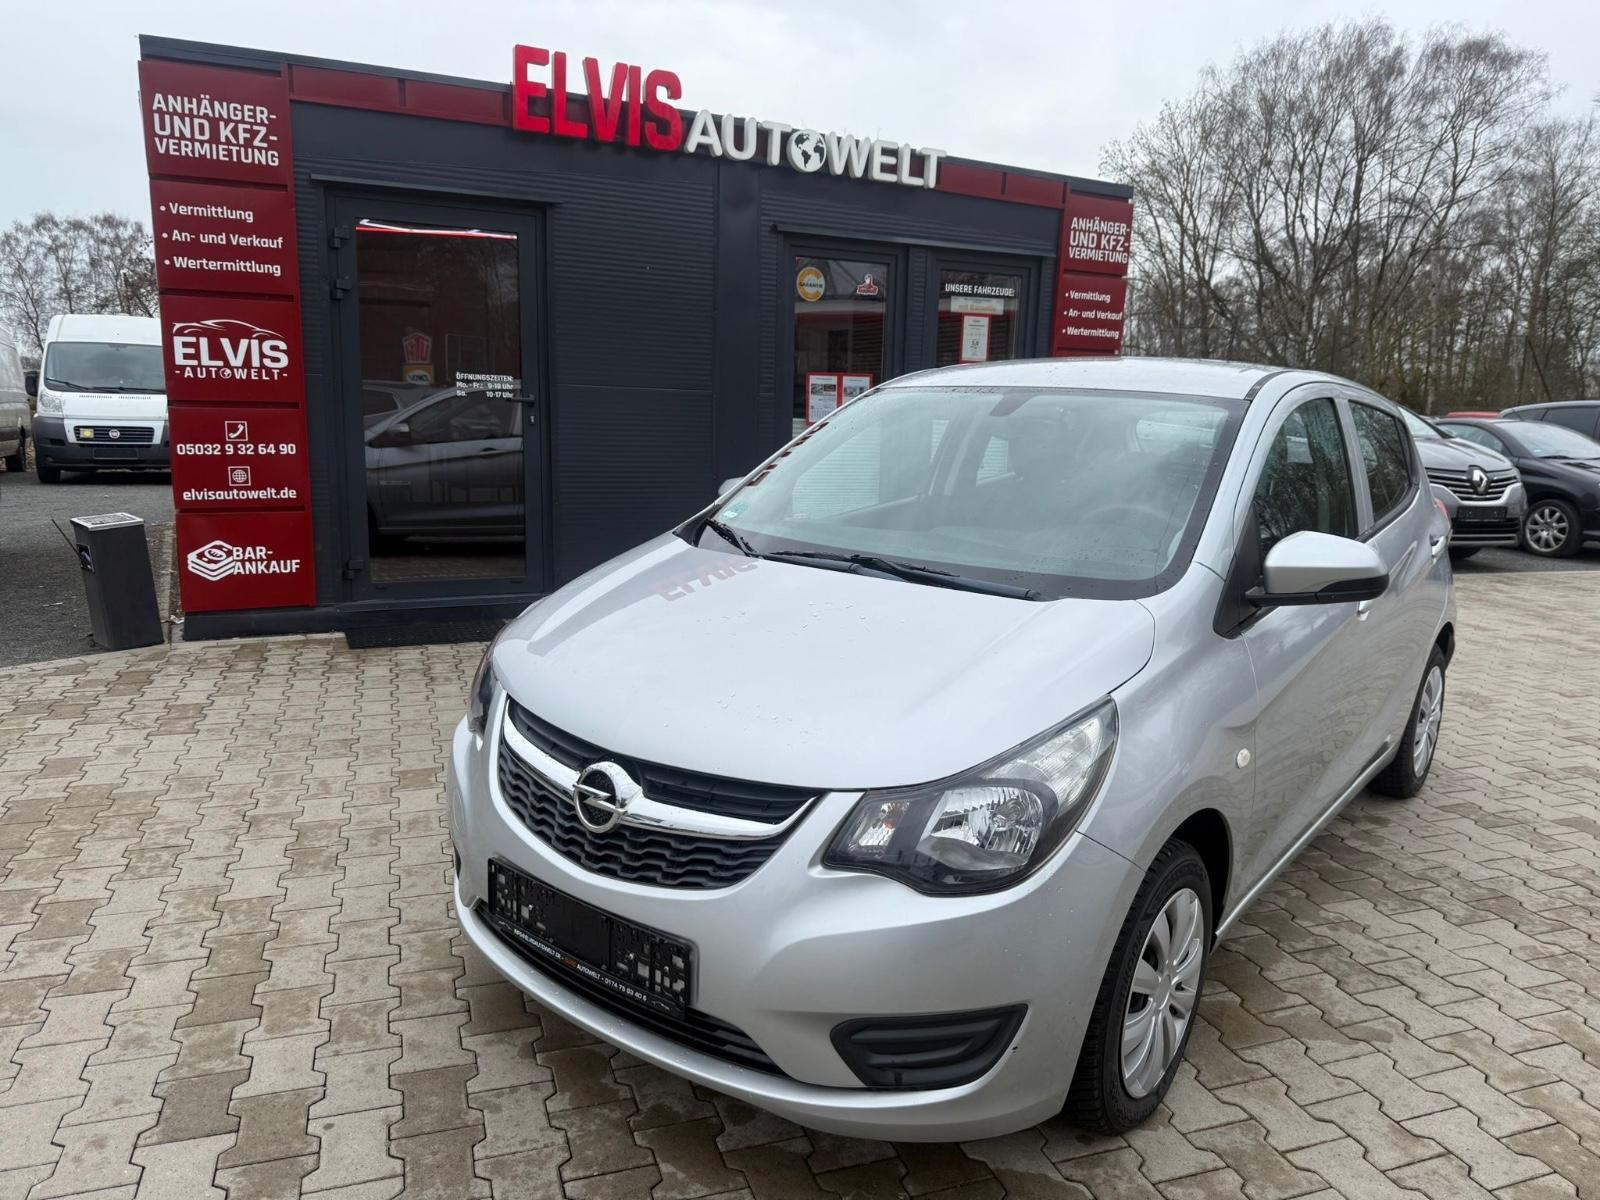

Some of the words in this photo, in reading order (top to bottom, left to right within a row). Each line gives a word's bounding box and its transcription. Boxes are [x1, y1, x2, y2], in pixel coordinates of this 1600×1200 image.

[513, 44, 683, 151] ELVIS
[152, 93, 277, 124] ANHÄNGER-
[153, 113, 210, 141] UND
[219, 121, 278, 148] KFZ-
[154, 137, 280, 167] VERMIETUNG
[169, 203, 254, 223] Vermittlung
[1070, 216, 1130, 235] ANHÄNGER-
[172, 229, 195, 242] An-
[200, 232, 226, 245] und
[230, 234, 283, 249] Verkauf
[1069, 231, 1097, 248] UND
[1101, 234, 1129, 251] KFZ-
[1069, 246, 1128, 264] VERMIETUNG
[173, 256, 281, 277] Wertermittlung
[945, 283, 973, 293] UNSERE
[974, 285, 1015, 297] FAHRZEUGE:
[1069, 290, 1111, 303] Vermittlung
[1068, 308, 1080, 317] An-
[1082, 309, 1095, 319] und
[1096, 310, 1122, 321] Verkauf
[1066, 326, 1119, 340] Wertermittlung
[173, 335, 289, 369] ELVIS
[176, 443, 221, 455] 05032
[225, 443, 234, 455] 9
[237, 443, 254, 455] 32
[258, 443, 276, 455] 64
[279, 443, 296, 455] 90
[183, 487, 297, 501] elvisautowelt.de
[232, 546, 273, 561] BAR-
[233, 559, 300, 575] ANKAUF
